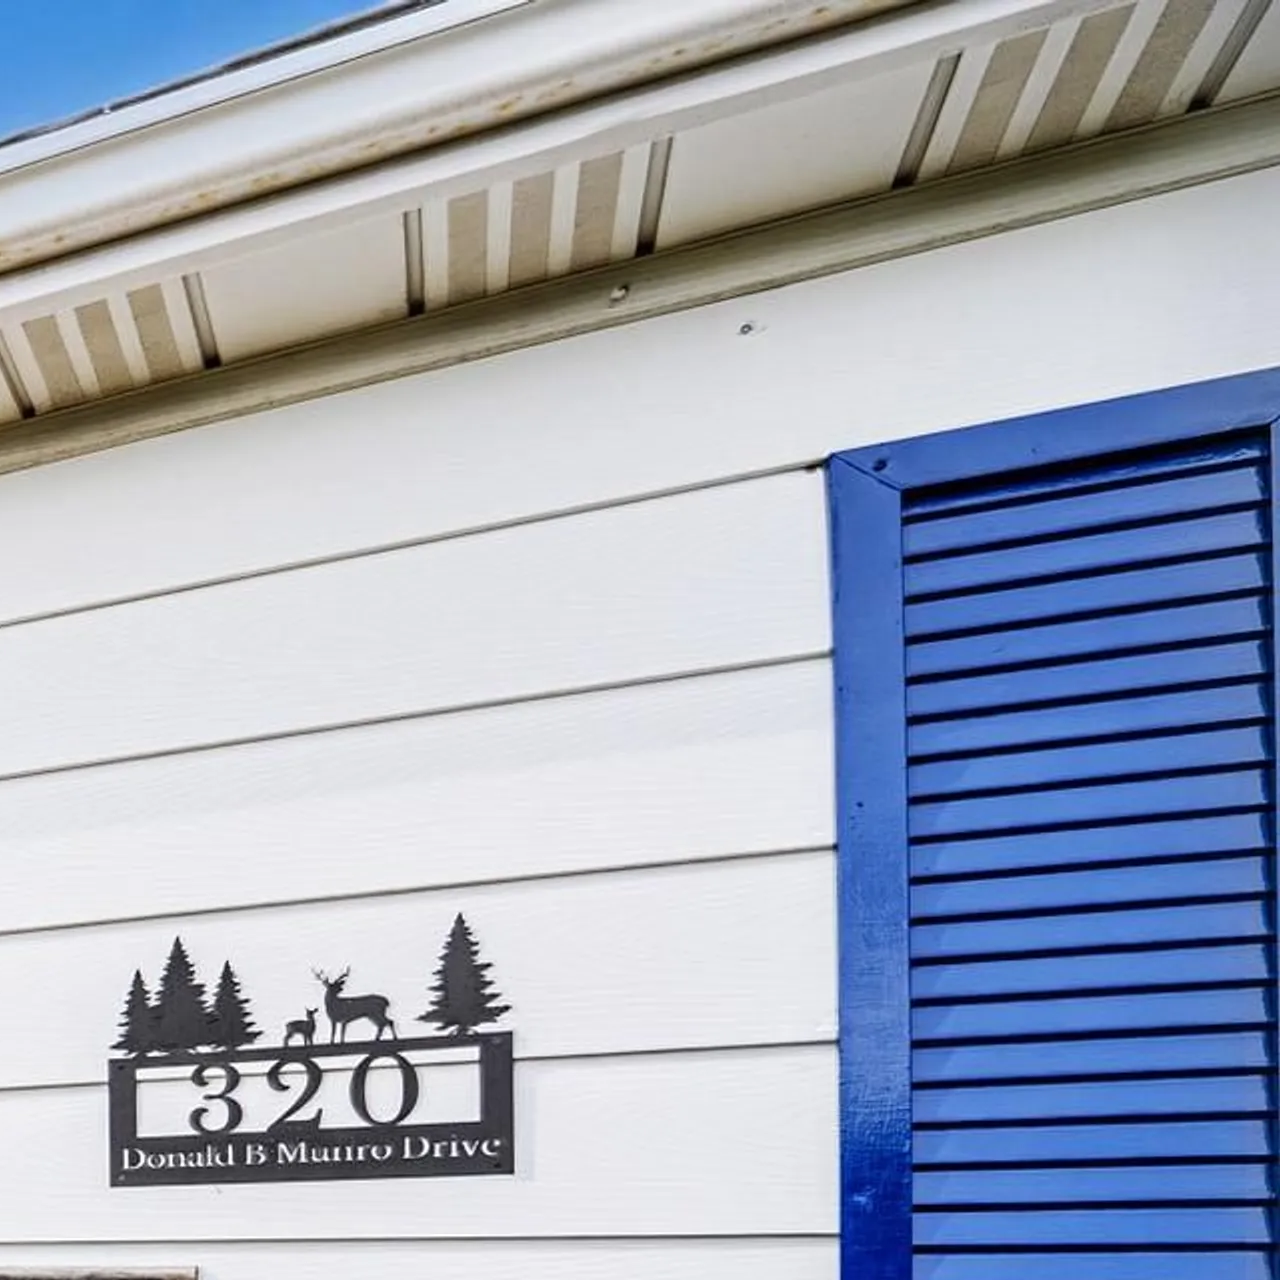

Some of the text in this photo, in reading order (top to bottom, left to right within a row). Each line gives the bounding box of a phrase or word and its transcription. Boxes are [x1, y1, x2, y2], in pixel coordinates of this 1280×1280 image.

[189, 1052, 420, 1134] 320
[122, 1134, 502, 1171] Donald B Munro Drive
